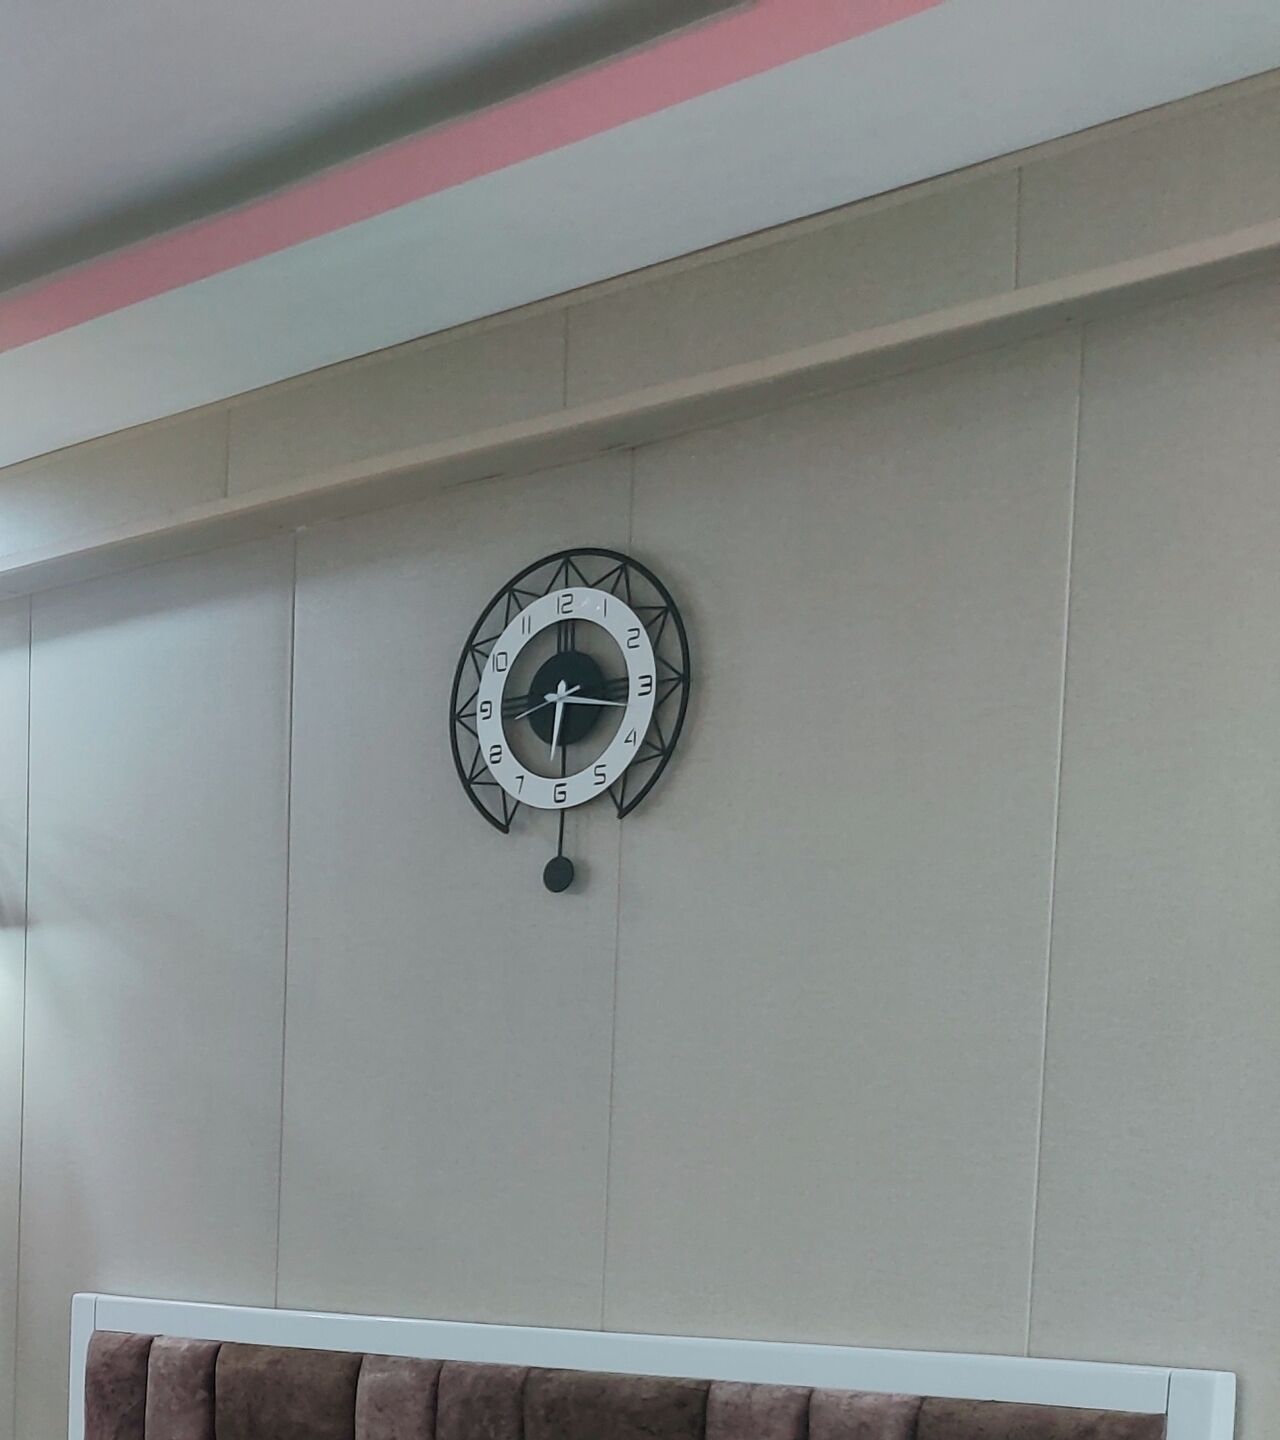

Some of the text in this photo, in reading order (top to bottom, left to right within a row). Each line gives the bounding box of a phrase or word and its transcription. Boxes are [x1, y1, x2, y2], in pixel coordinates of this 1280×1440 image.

[557, 593, 574, 615] 12
[522, 616, 531, 635] 11
[627, 628, 641, 649] 2
[493, 651, 508, 673] 10
[638, 675, 653, 696] 3
[480, 701, 492, 720] 9
[624, 728, 637, 746] 4
[490, 744, 503, 764] 8
[515, 775, 525, 794] 7
[594, 765, 607, 785] 5
[553, 783, 567, 803] 6
